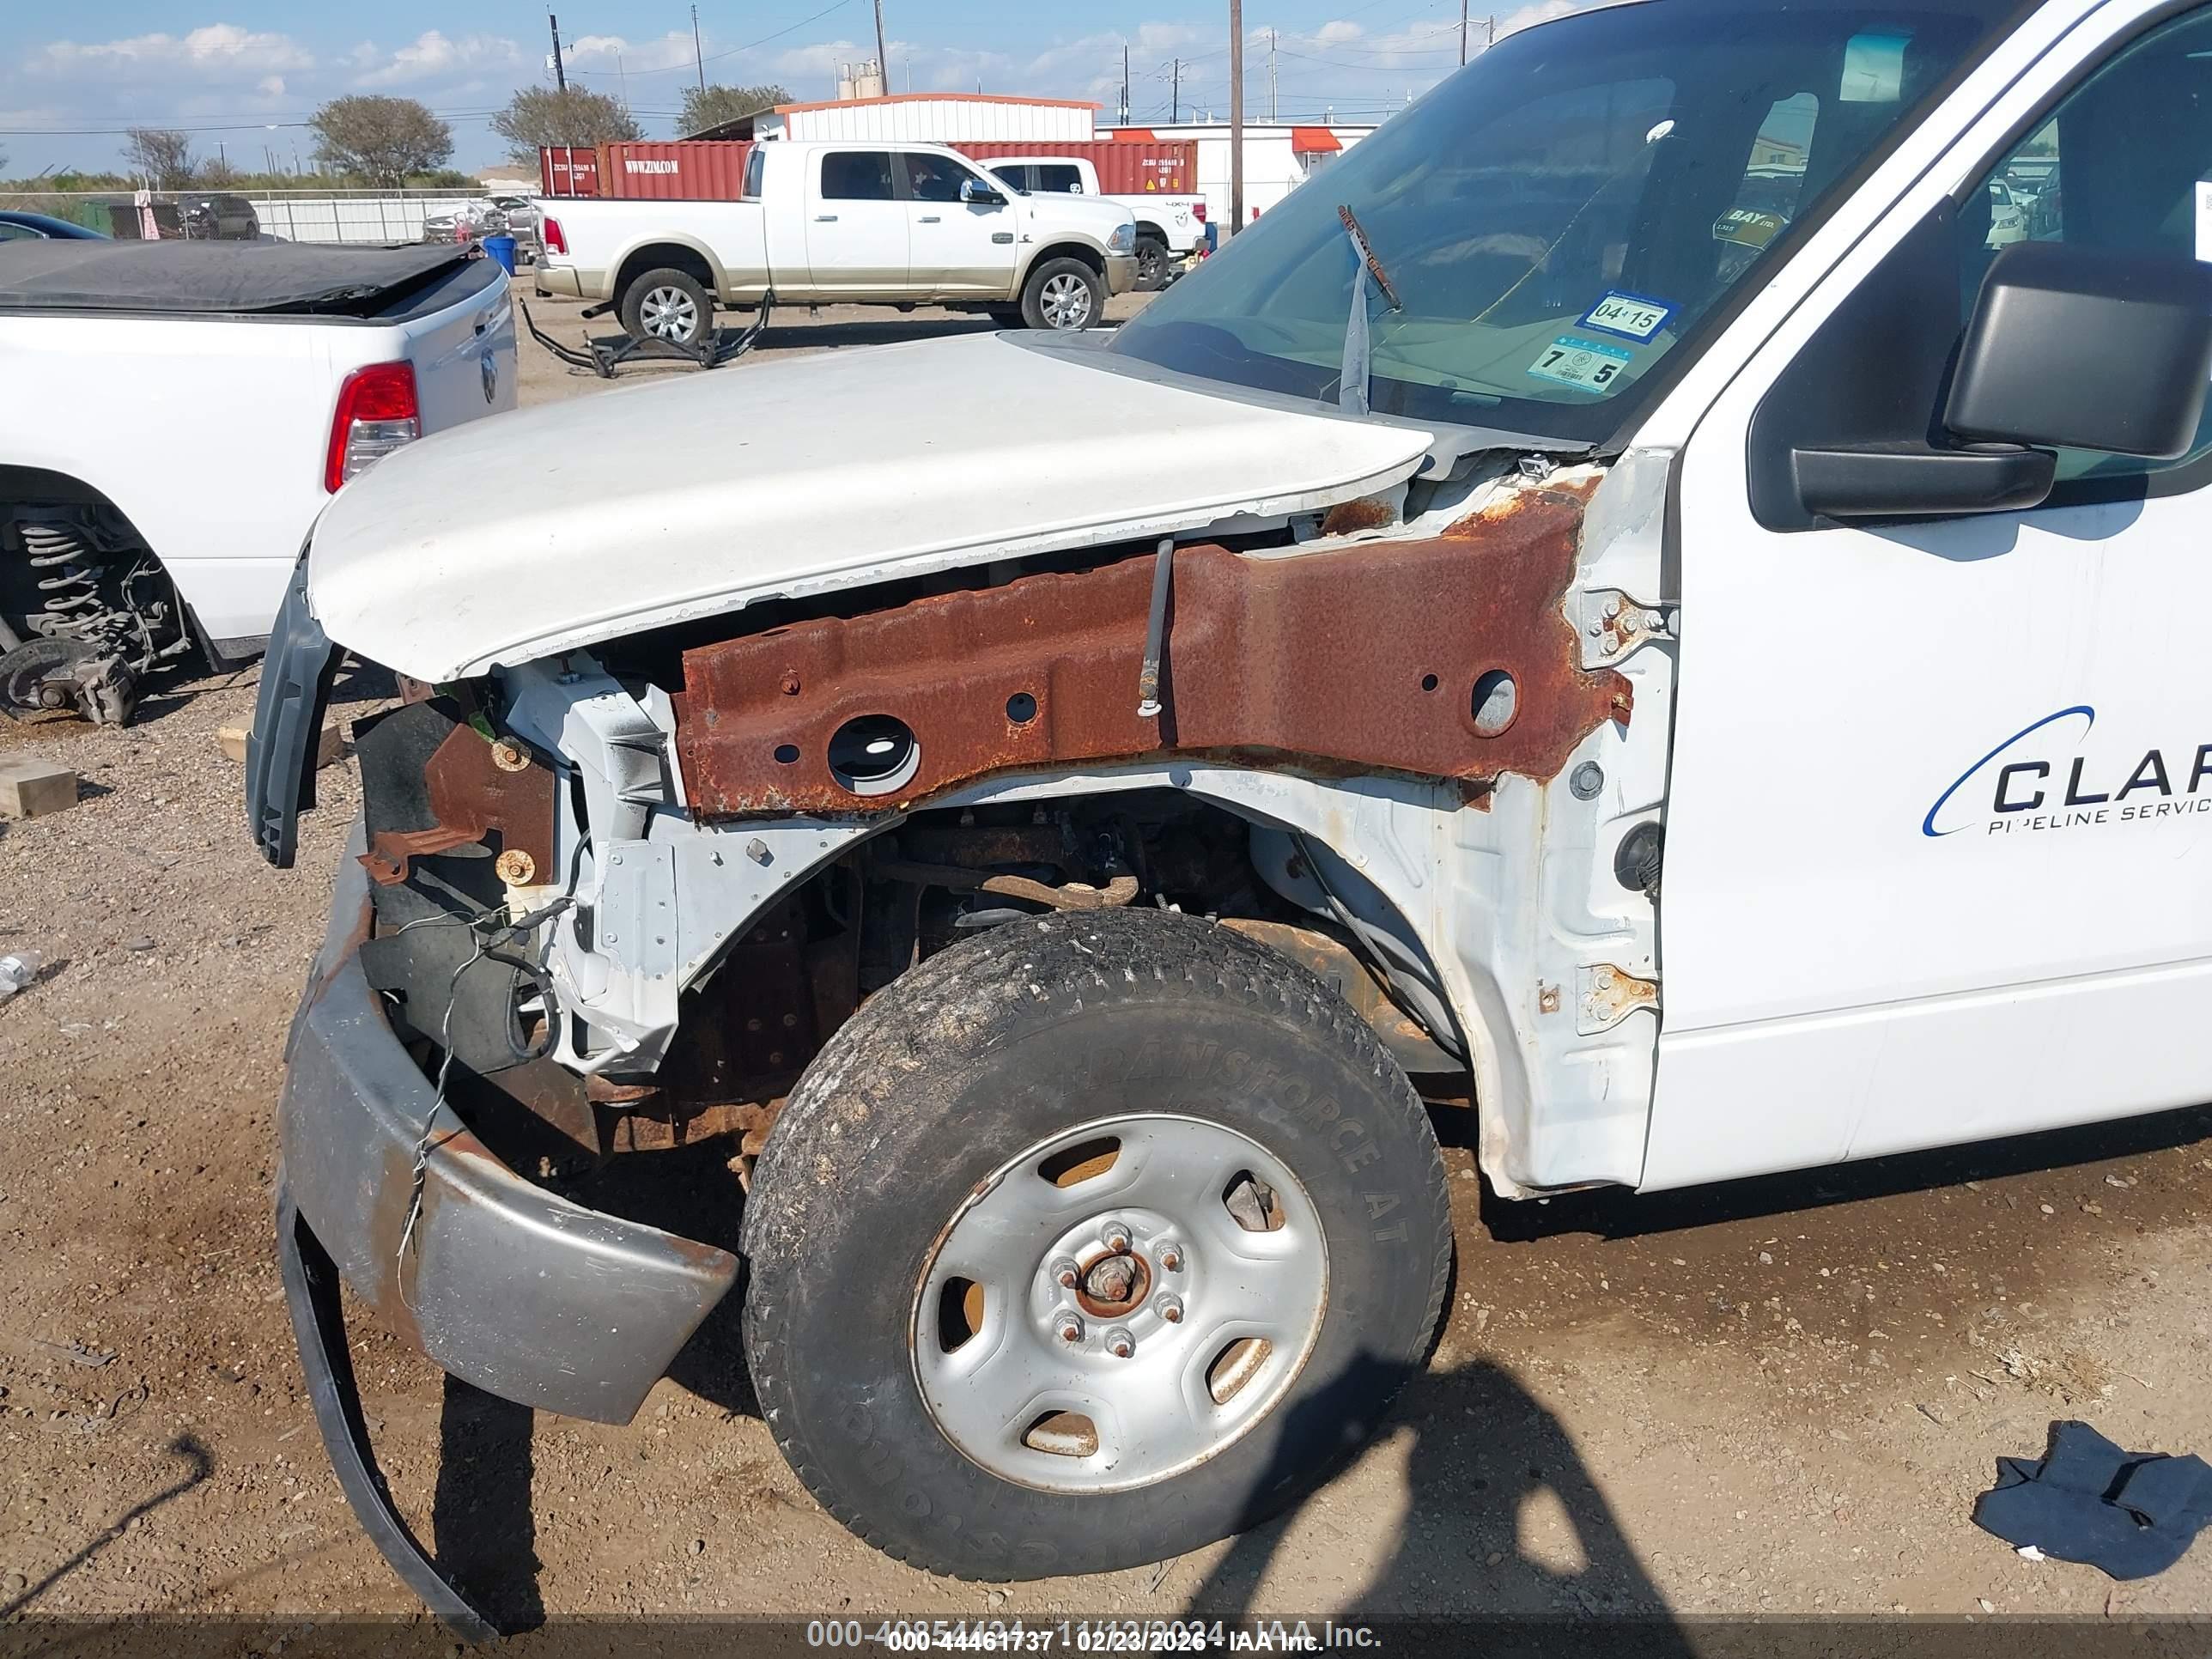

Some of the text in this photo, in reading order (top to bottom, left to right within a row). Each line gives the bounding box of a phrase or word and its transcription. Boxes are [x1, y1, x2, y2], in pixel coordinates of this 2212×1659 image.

[624, 160, 679, 173] WWW.ZIM.COM
[1728, 210, 1768, 224] BAY
[1595, 303, 1624, 320] 04
[1629, 311, 1657, 328] 15
[1541, 350, 1565, 368] 7
[1594, 364, 1618, 383] 5
[1988, 810, 2110, 836] PIELINE
[1363, 1190, 1409, 1244] AT
